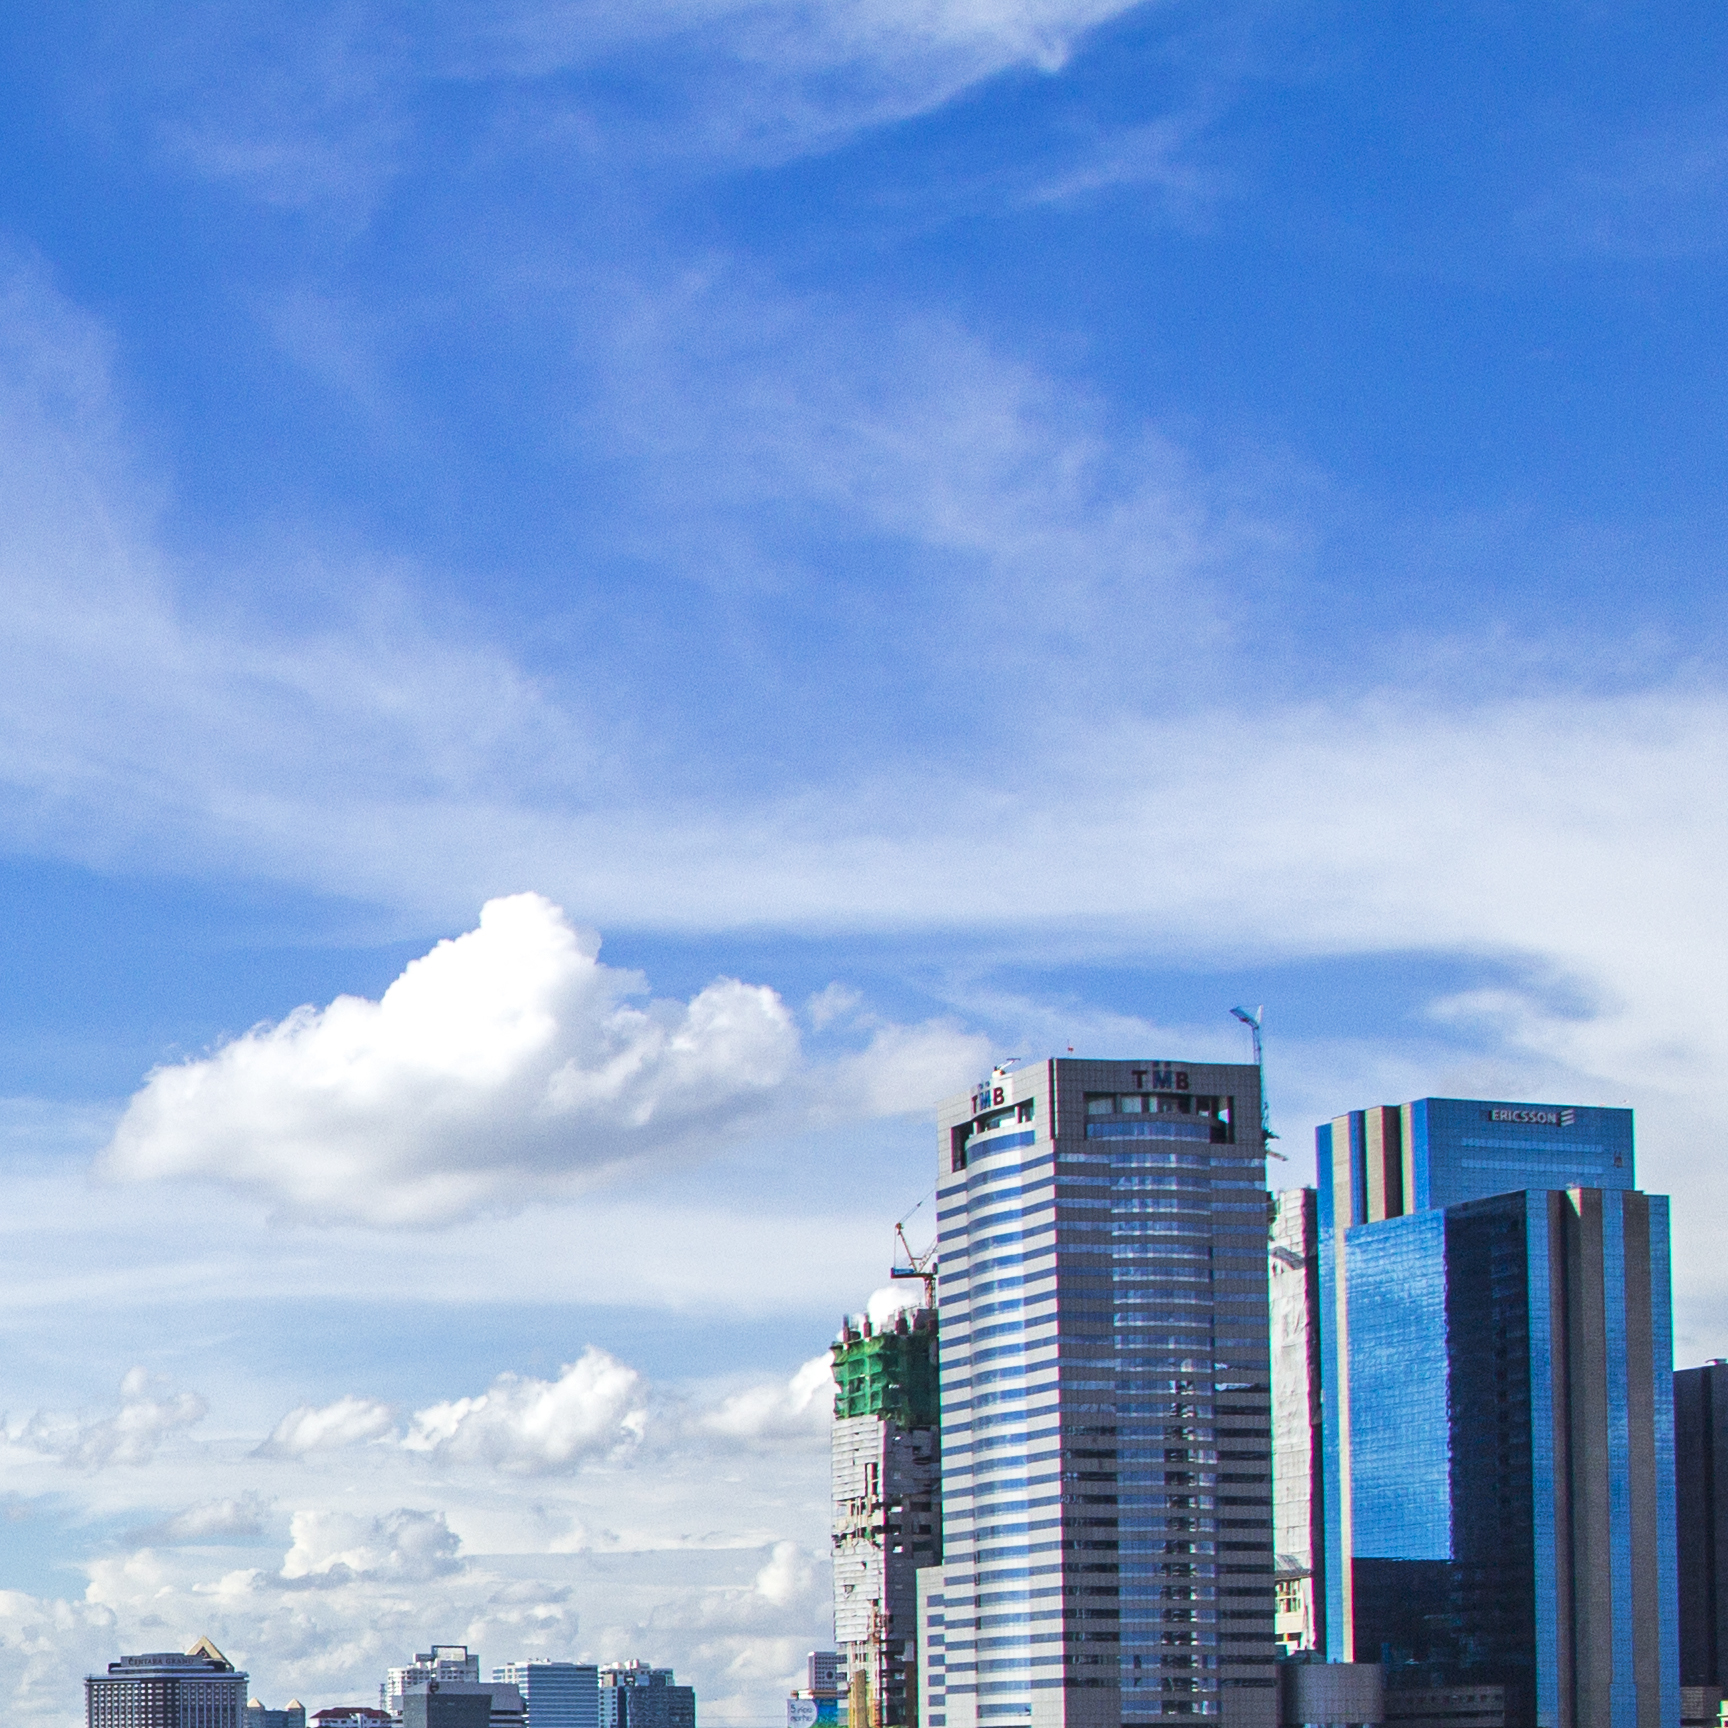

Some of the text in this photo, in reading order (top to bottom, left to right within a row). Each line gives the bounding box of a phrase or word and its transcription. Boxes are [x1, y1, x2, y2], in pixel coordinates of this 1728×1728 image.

[1131, 1069, 1190, 1090] TMB
[971, 1085, 1005, 1114] TMB
[1491, 1109, 1558, 1124] ERICSSON
